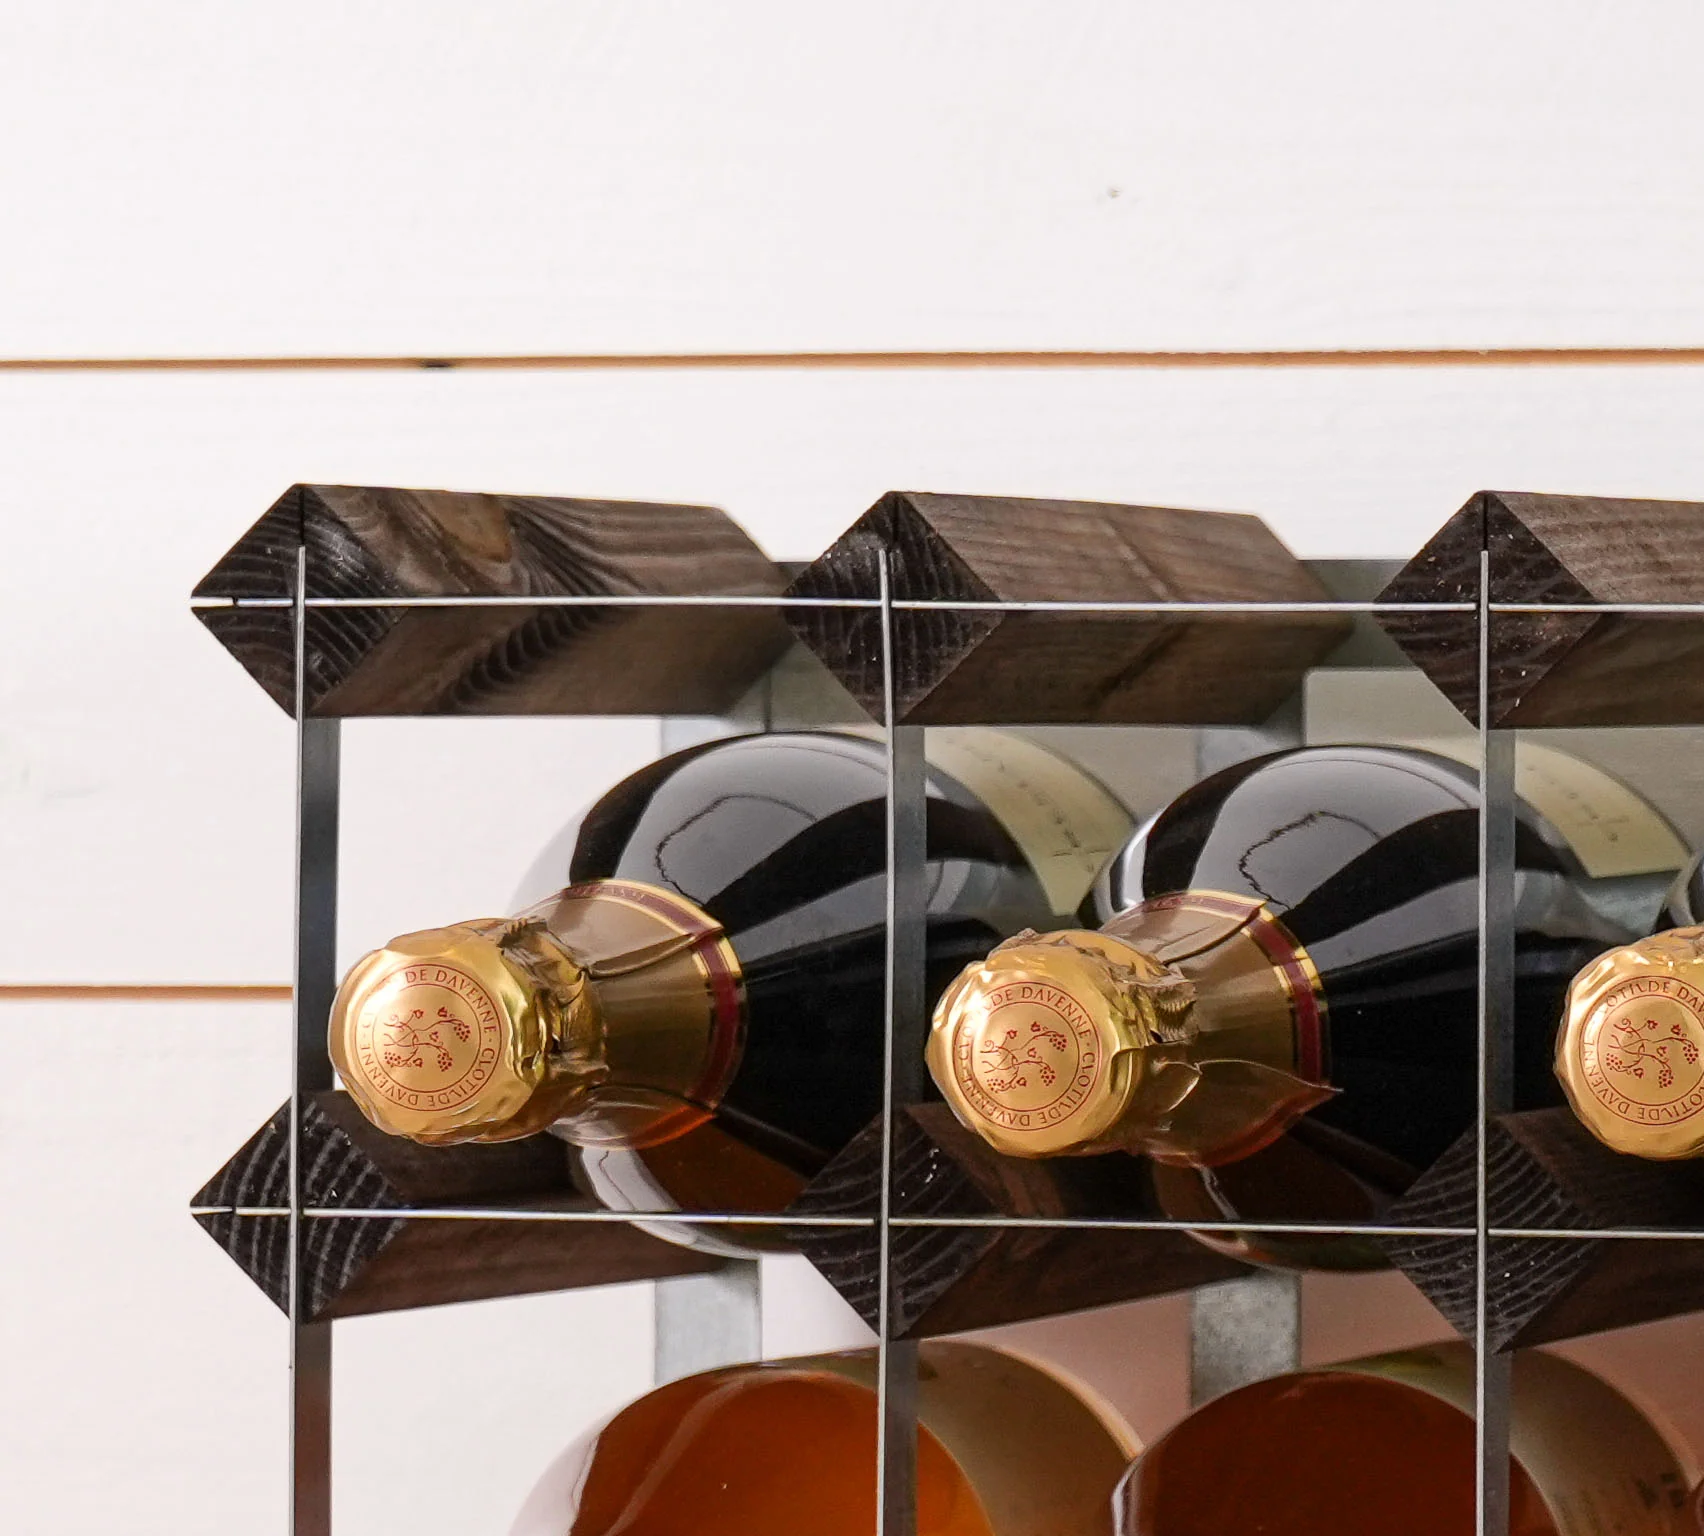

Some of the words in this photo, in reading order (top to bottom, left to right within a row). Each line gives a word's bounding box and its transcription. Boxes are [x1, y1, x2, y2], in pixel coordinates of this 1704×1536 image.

[434, 968, 497, 1033] DAVENNE
[1020, 986, 1092, 1039] DAVENNE
[359, 1042, 419, 1106] DAVENNE
[426, 1045, 496, 1106] CLOTILDE
[962, 1074, 1030, 1126] DAVENNE
[1036, 1051, 1095, 1125] CLOTILDE
